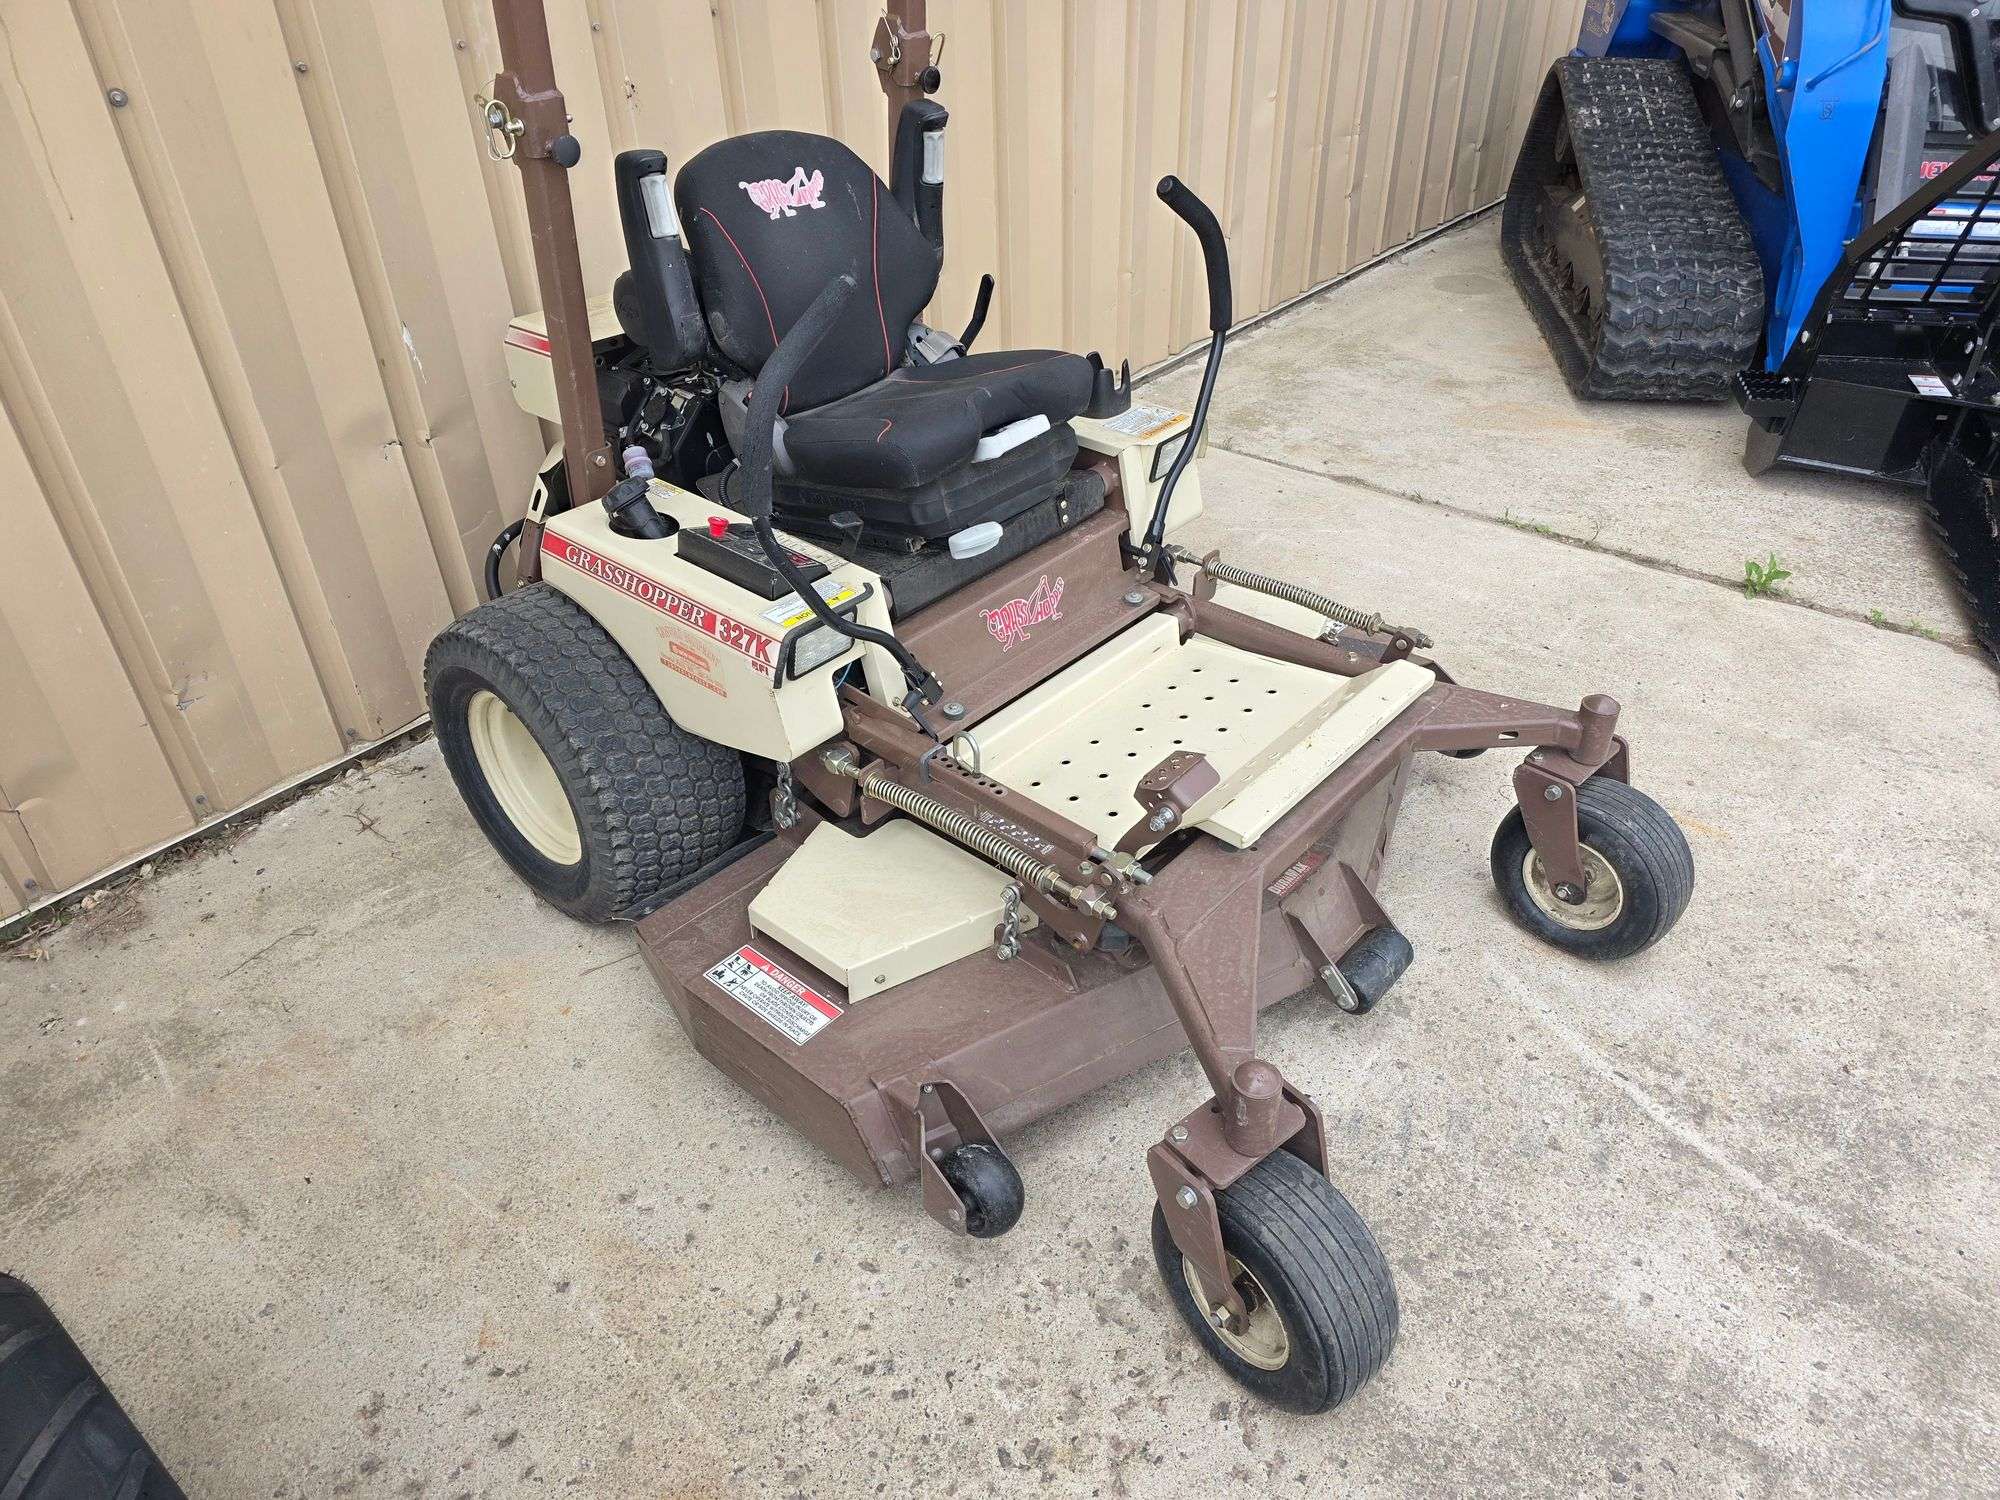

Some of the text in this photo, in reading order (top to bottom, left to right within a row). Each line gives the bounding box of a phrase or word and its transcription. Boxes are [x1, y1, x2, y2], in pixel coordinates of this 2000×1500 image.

[565, 544, 705, 628] GRASSHOPPER
[718, 617, 772, 664] 327K
[769, 968, 806, 995] DANGER
